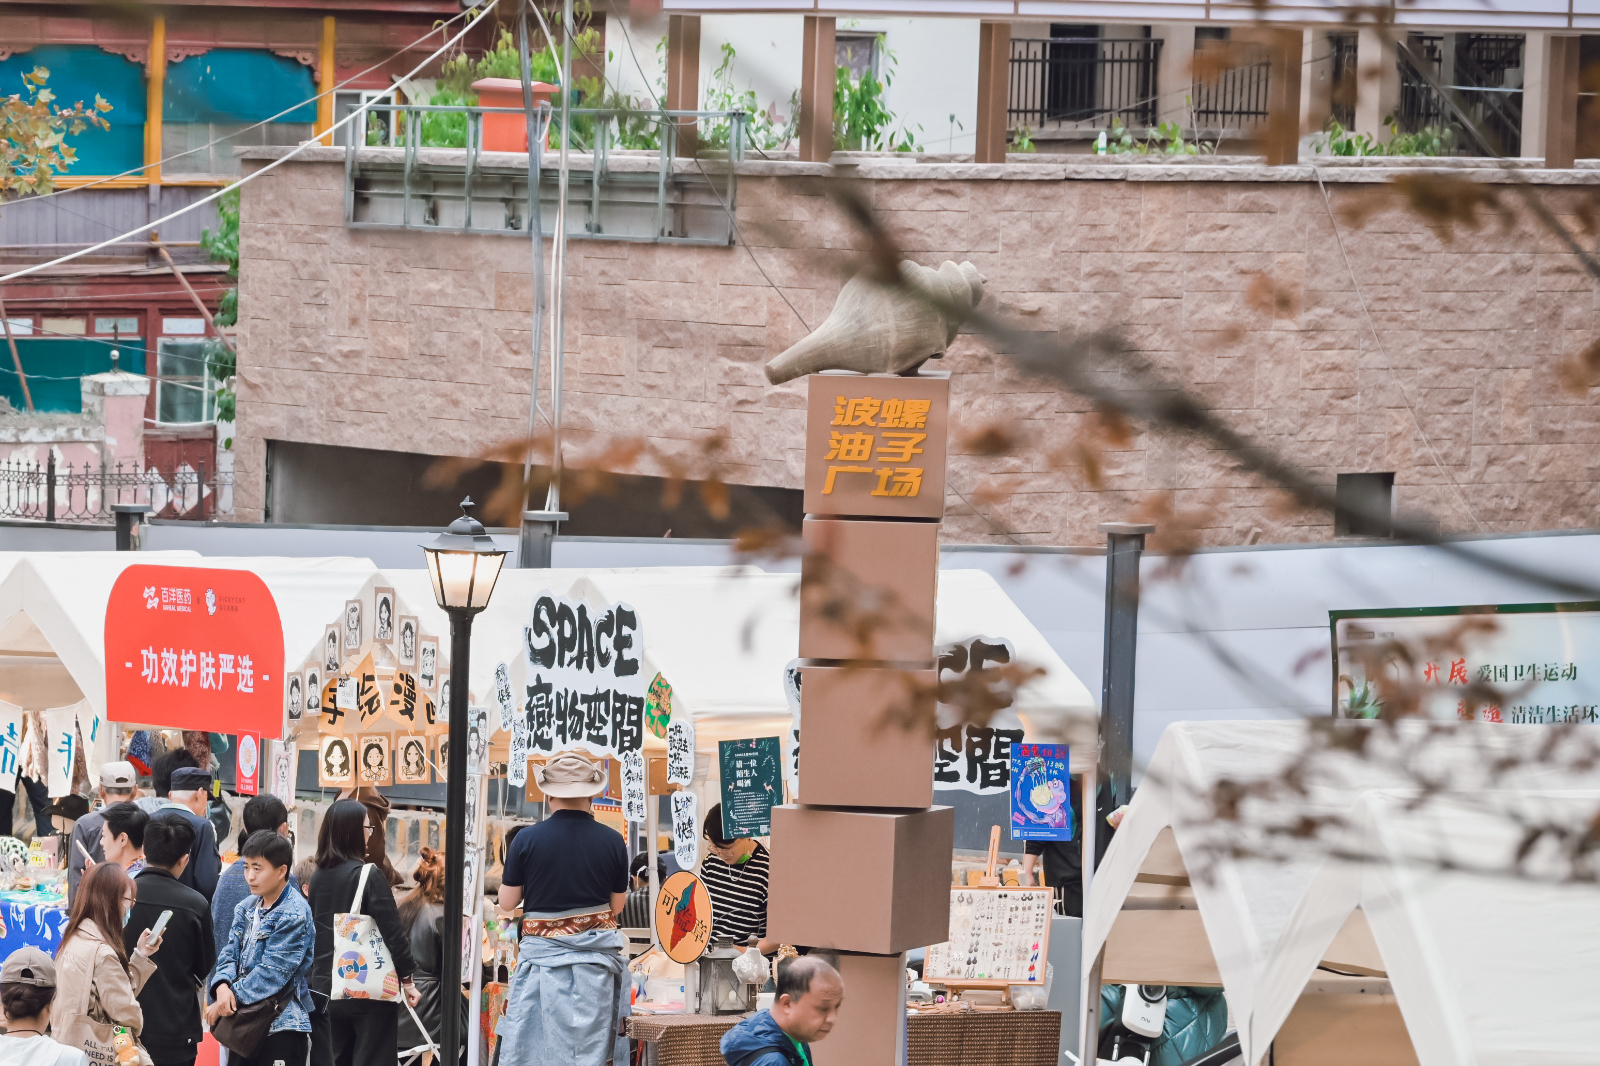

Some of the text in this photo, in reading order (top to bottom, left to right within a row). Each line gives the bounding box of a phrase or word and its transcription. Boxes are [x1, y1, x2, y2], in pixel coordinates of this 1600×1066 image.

[830, 395, 932, 428] 波螺
[823, 430, 927, 463] 油子
[821, 465, 925, 497] 广场
[161, 587, 192, 605] 百洋医药
[529, 595, 640, 678] SPACE
[140, 645, 254, 693] 功效护肤严选
[1476, 662, 1578, 684] 爱国卫生运动
[83, 1039, 98, 1050] ALL
[85, 1049, 114, 1063] NEED IS
